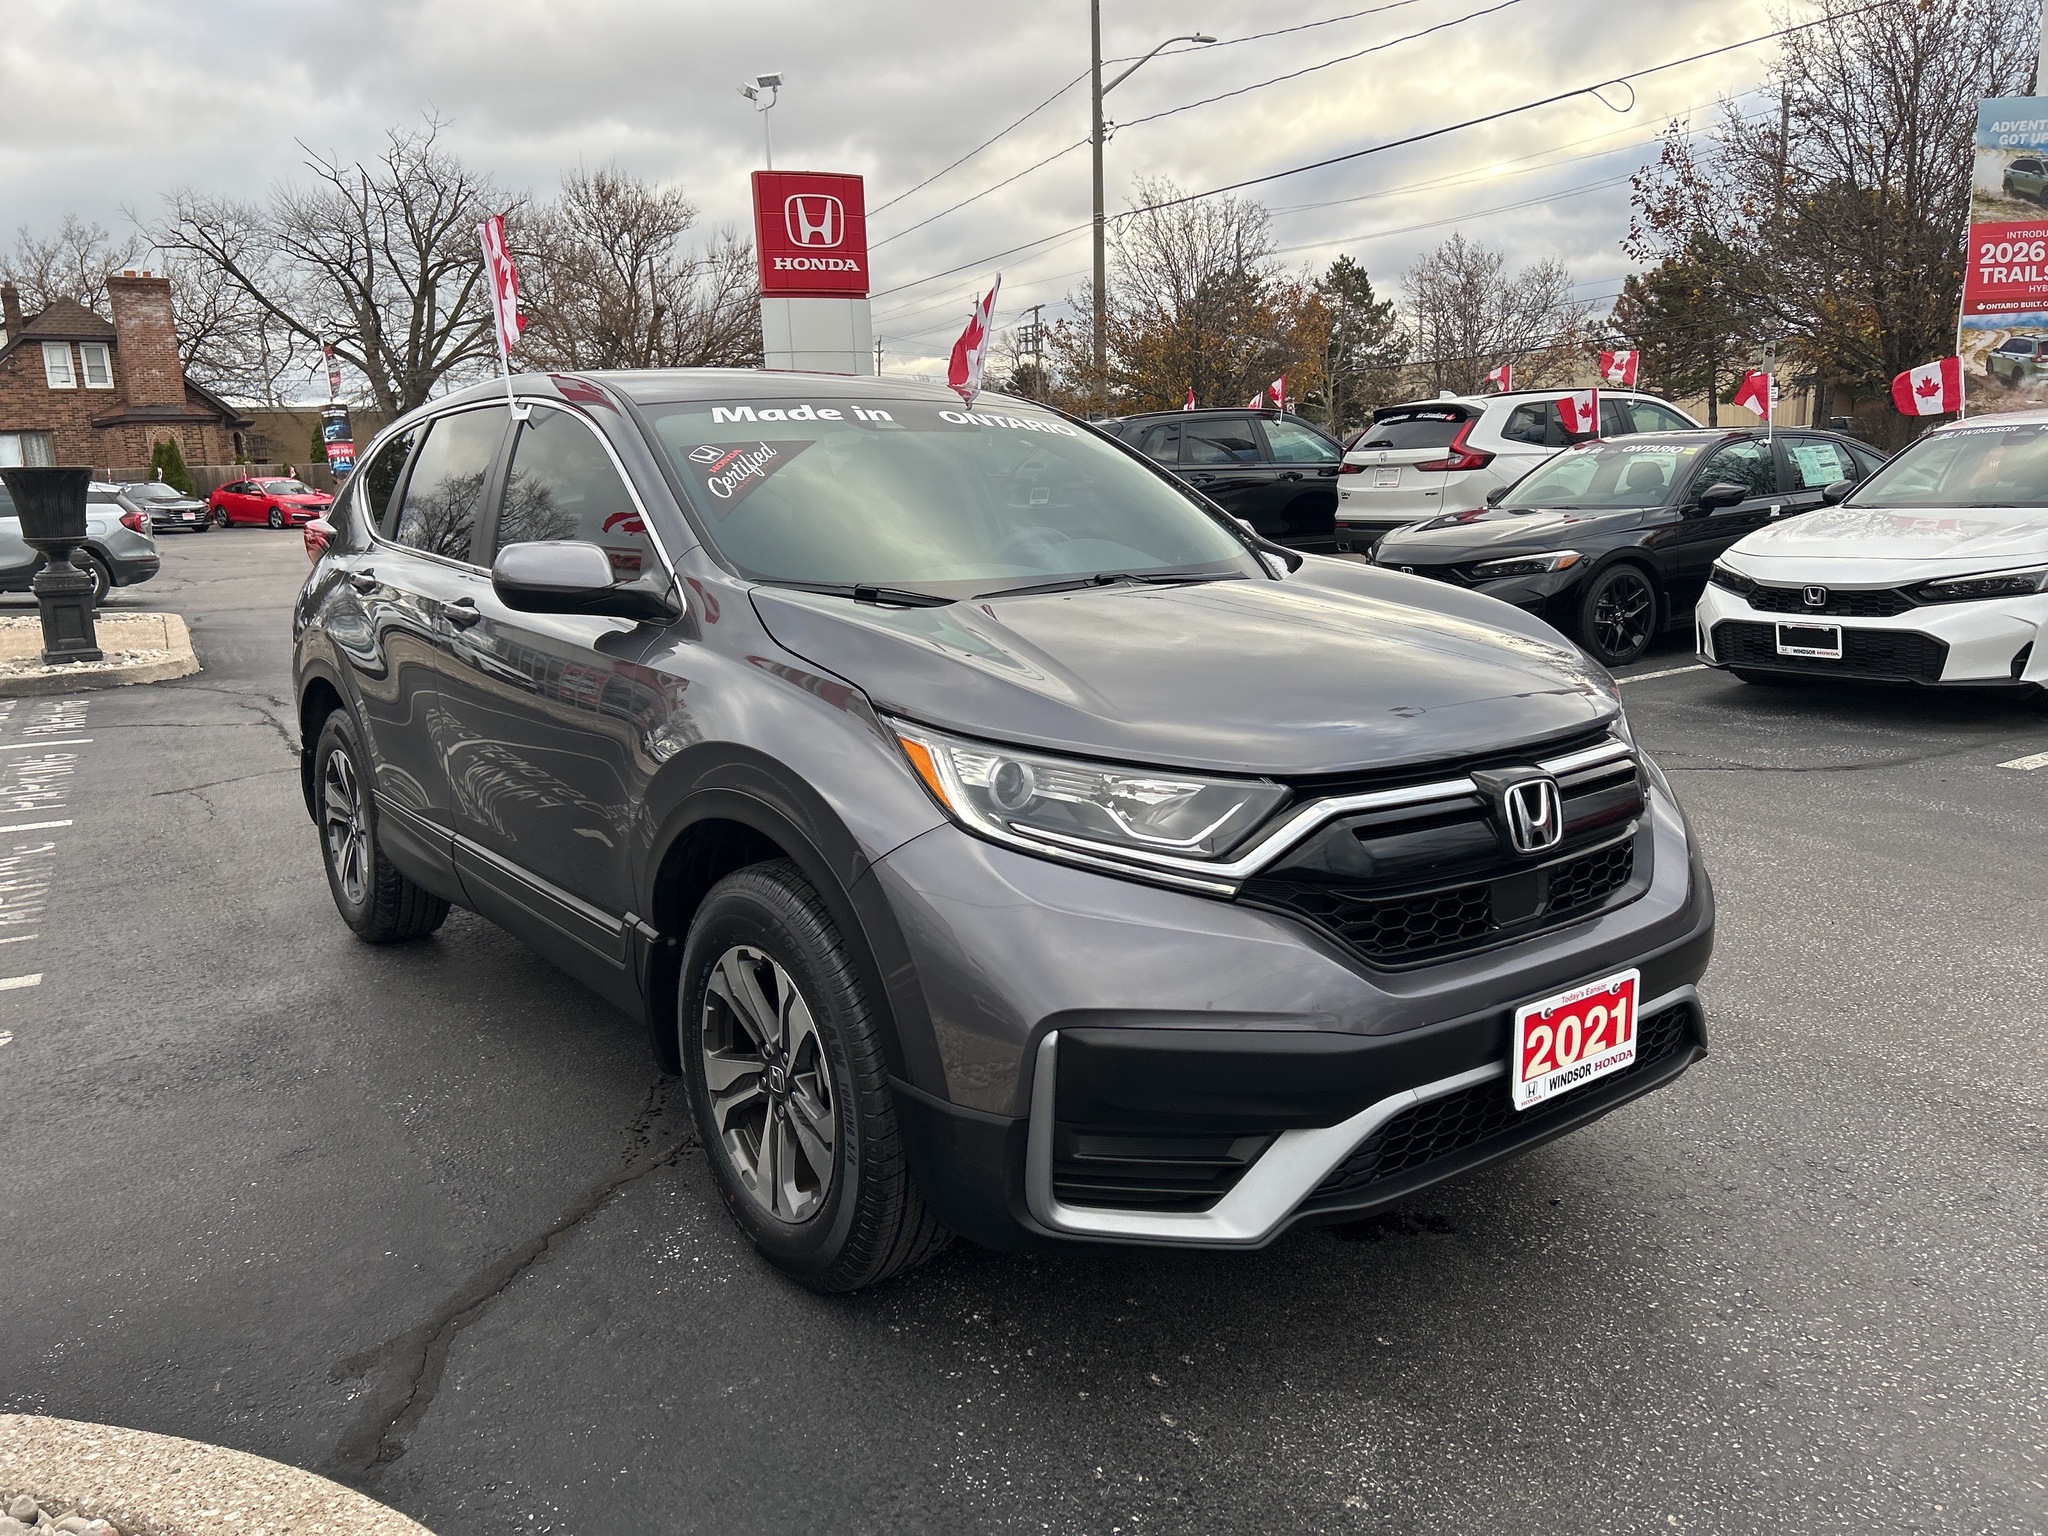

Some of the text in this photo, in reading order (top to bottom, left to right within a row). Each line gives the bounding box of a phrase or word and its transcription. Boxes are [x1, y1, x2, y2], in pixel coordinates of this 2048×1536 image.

[1989, 119, 2048, 133] ADVENT
[1998, 133, 2029, 145] GOT
[1980, 240, 2046, 264] 2026
[773, 257, 860, 272] HONDA
[711, 404, 894, 424] Made in
[938, 410, 1078, 437] ONTARIO
[1622, 445, 1685, 453] ONTARIO
[707, 441, 778, 499] Certified
[708, 449, 743, 473] HONDA
[1792, 648, 1816, 656] WINDSOR
[1561, 991, 1585, 1004] Today's
[1524, 997, 1627, 1080] 2021
[1549, 1049, 1634, 1092] WINDSOR HONDA
